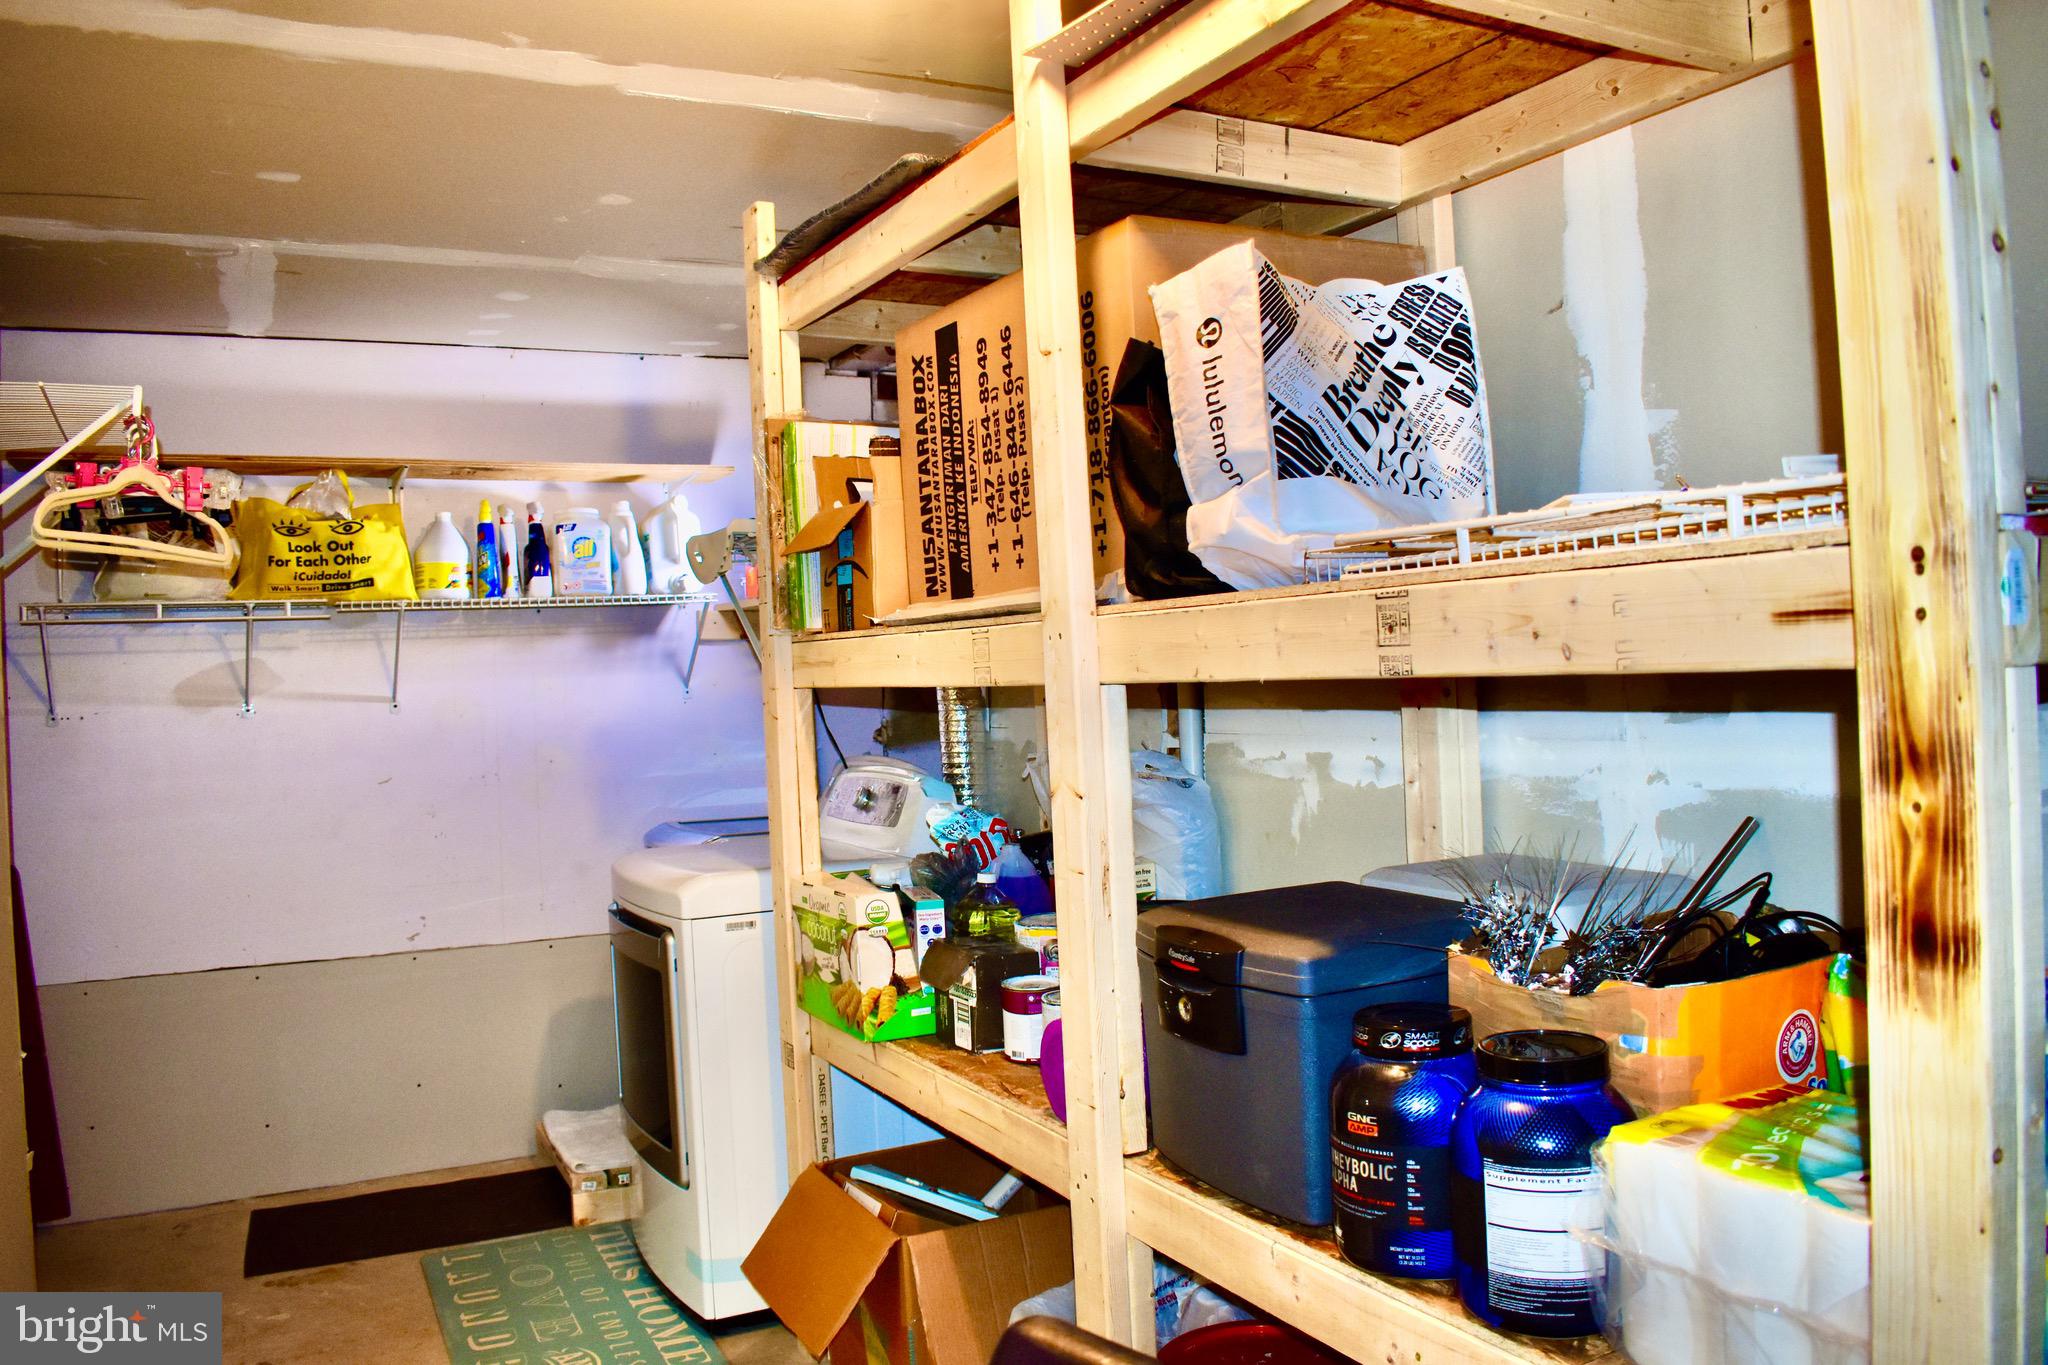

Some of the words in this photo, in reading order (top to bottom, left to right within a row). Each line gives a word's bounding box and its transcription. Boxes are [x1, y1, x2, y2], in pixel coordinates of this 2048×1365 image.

[1387, 283, 1435, 330] STRESS
[1412, 291, 1463, 347] RELATED
[1403, 335, 1433, 360] IS
[1429, 352, 1460, 375] TO
[989, 385, 999, 404] 1)
[1014, 375, 1025, 396] 2)
[1321, 324, 1397, 423] Breathe
[1444, 384, 1474, 408] OF
[939, 385, 952, 430] DARI
[949, 353, 964, 460] INDONESIA
[1080, 290, 1108, 557] +1-718-866-6006
[1202, 354, 1244, 487] lululemon
[1345, 350, 1424, 453] Deeply
[991, 406, 1001, 465] Pusat
[1000, 324, 1025, 570] +1-646-846-6446
[1017, 400, 1026, 457] Pusat
[1307, 414, 1320, 425] will
[1319, 424, 1331, 443] never
[1337, 451, 1354, 469] found
[1314, 406, 1325, 419] The
[1324, 417, 1337, 434] most
[1335, 433, 1360, 463] important
[1425, 413, 1446, 441] WORLD
[1438, 420, 1451, 439] NOT
[1449, 416, 1465, 440] HOLD
[911, 355, 940, 598] NUSANTARABOX
[926, 355, 948, 593] WWW.NUSANTARABOX.COM
[954, 461, 965, 485] KE
[966, 418, 979, 506] TELP/WA:
[976, 337, 1000, 573] +1-347-854-8949
[941, 436, 958, 553] PENGIRIMAN
[995, 463, 1006, 524] (Telp.
[1021, 459, 1032, 519] (Telp.
[287, 540, 323, 553] Look
[327, 540, 354, 553] Out
[574, 540, 594, 558] all
[955, 484, 970, 573] AMERIKA
[267, 555, 291, 568] For
[296, 554, 329, 567] Each
[333, 552, 372, 566] Other
[293, 570, 352, 582] ¡Cuidado!
[325, 583, 348, 591] Drive
[349, 580, 372, 589] Smart
[806, 918, 837, 947] coconut
[1403, 1039, 1440, 1048] SCOOP
[1404, 1031, 1440, 1040] SMART
[1782, 1032, 1791, 1054] ARM
[1795, 1017, 1813, 1046] HAMMER
[820, 1115, 828, 1134] PET
[1347, 1111, 1377, 1125] GNC
[1349, 1123, 1375, 1134] AMP
[821, 1136, 829, 1155] Bar
[1486, 1171, 1561, 1185] Supplement
[497, 1240, 583, 1343] LOVE
[560, 1251, 595, 1282] FULL
[580, 1287, 610, 1303] OF
[588, 1225, 642, 1282] THIS
[623, 1286, 712, 1365] HOME
